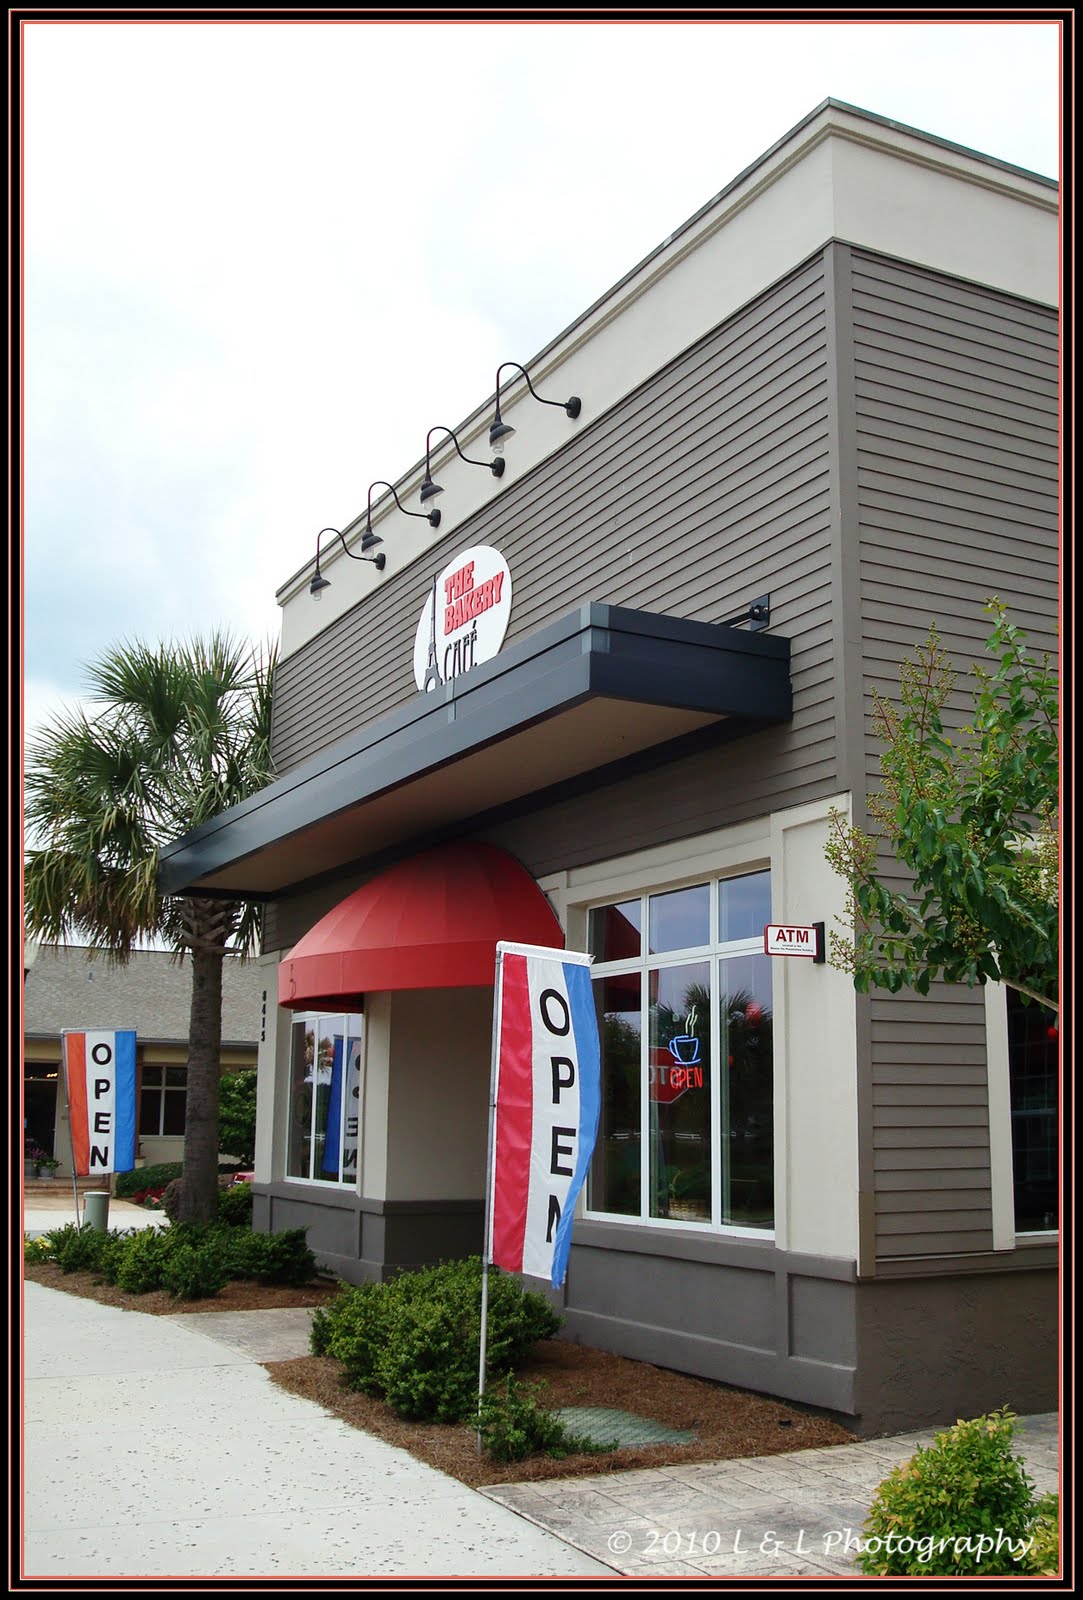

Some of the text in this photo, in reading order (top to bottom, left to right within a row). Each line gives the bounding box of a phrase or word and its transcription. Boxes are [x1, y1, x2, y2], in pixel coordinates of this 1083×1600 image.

[444, 561, 475, 605] THE
[444, 571, 505, 636] BAKERY
[775, 929, 809, 943] ATM
[670, 1067, 703, 1089] OPEN
[90, 1043, 112, 1167] OPEN
